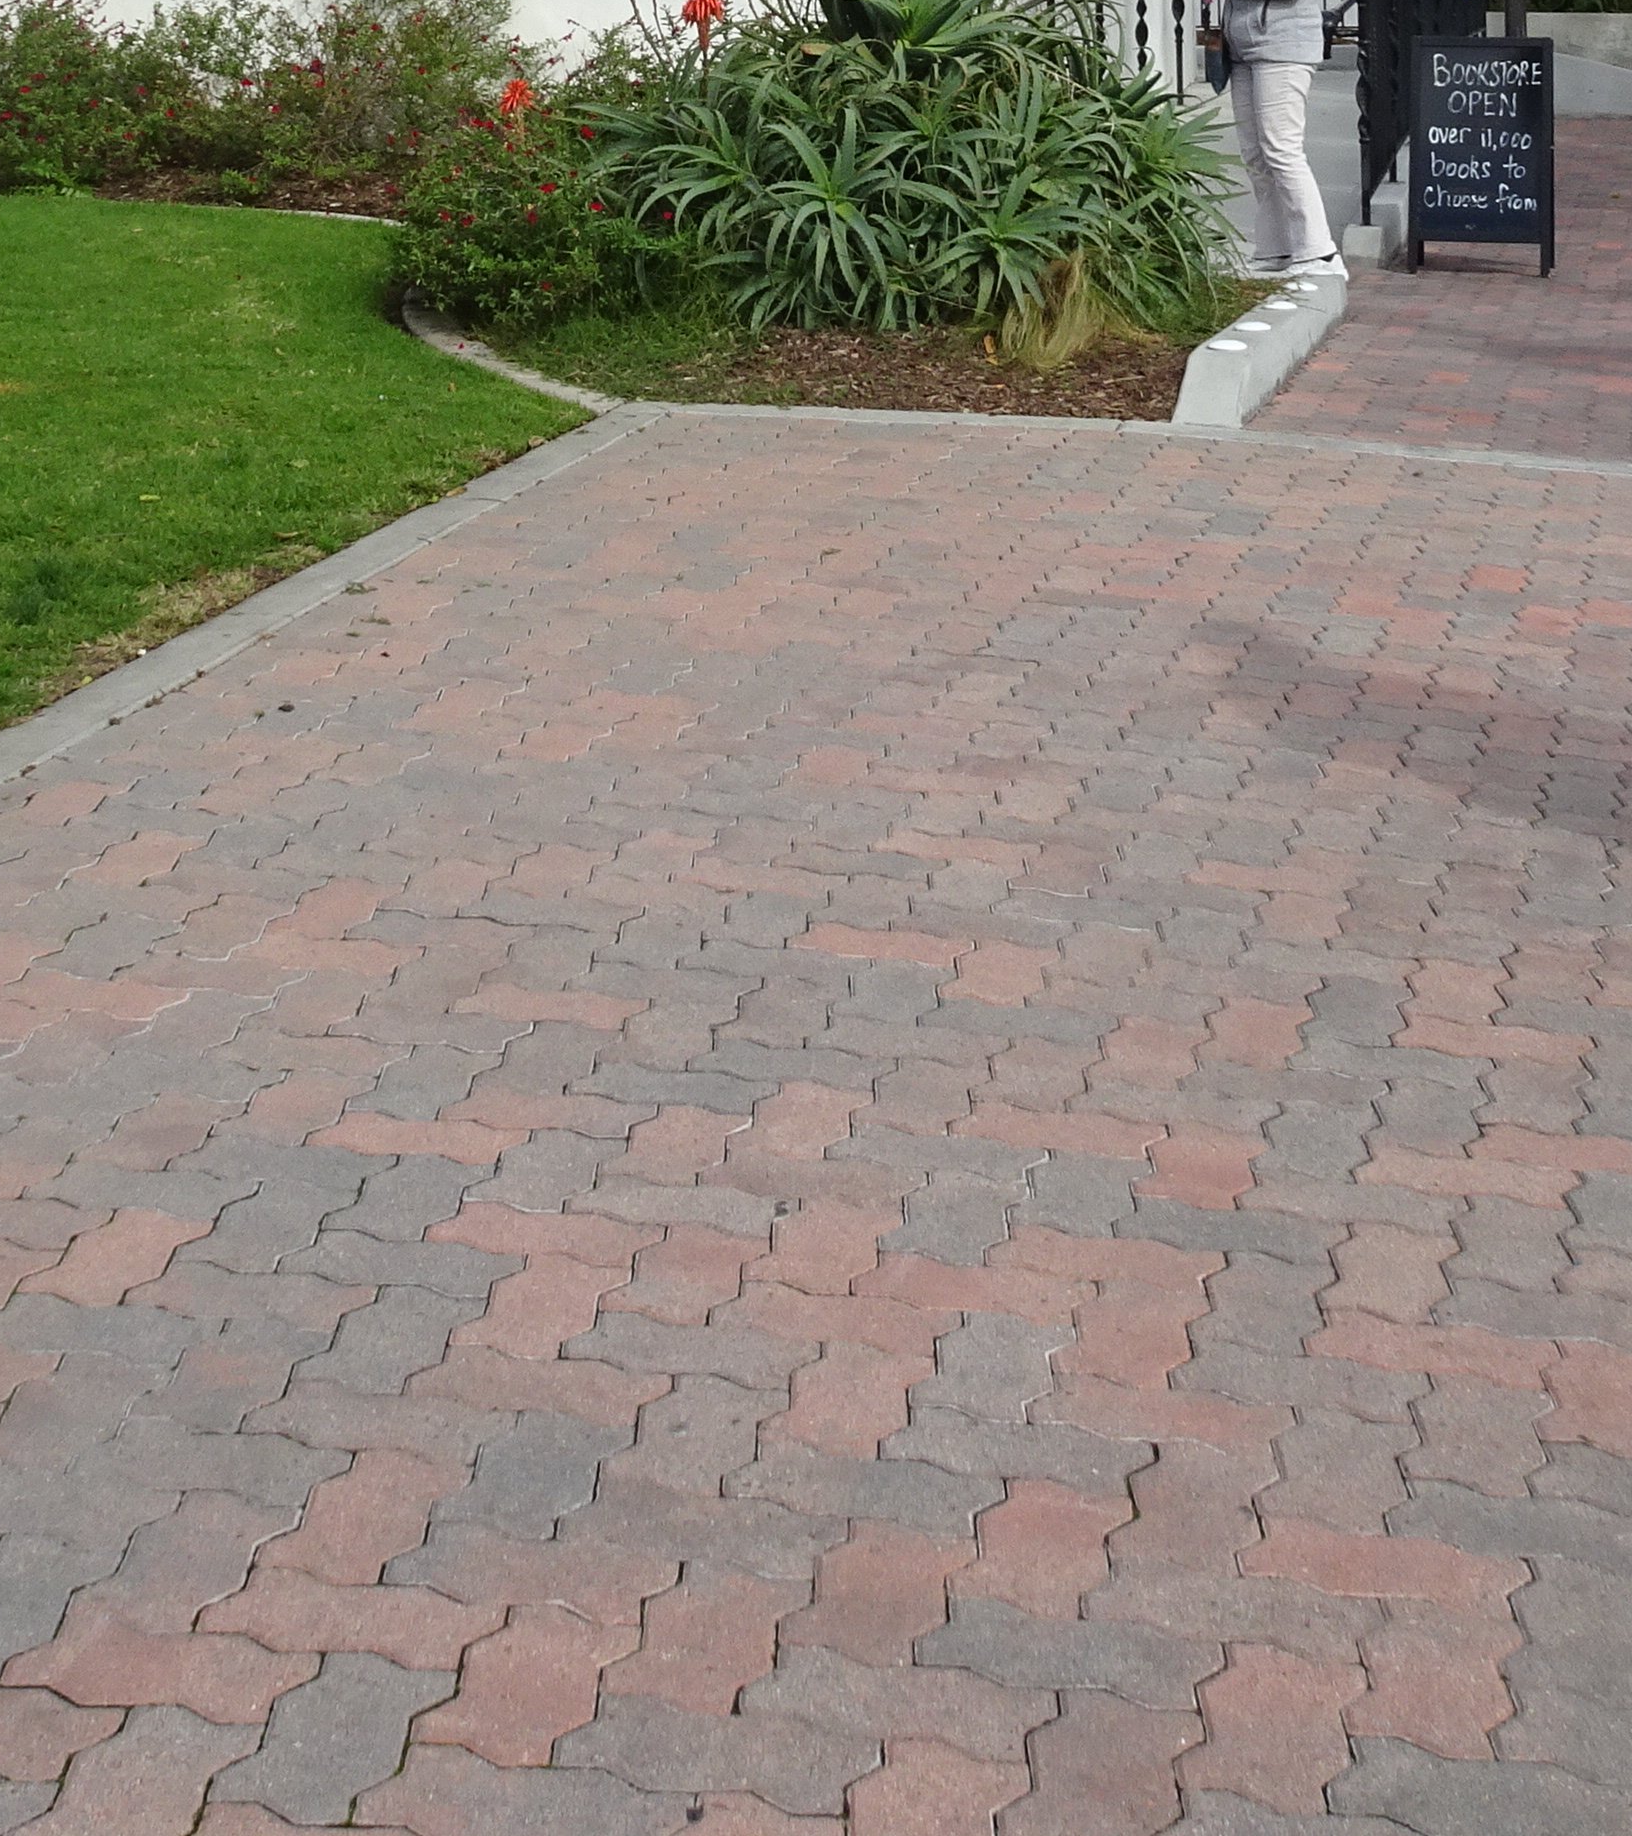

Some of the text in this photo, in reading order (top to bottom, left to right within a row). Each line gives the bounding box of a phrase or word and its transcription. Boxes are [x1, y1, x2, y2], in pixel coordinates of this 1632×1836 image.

[1433, 53, 1542, 87] BOOKSTORE
[1447, 90, 1517, 117] OPEN
[1428, 126, 1472, 144] over
[1430, 151, 1527, 179] books to
[1495, 183, 1538, 214] from
